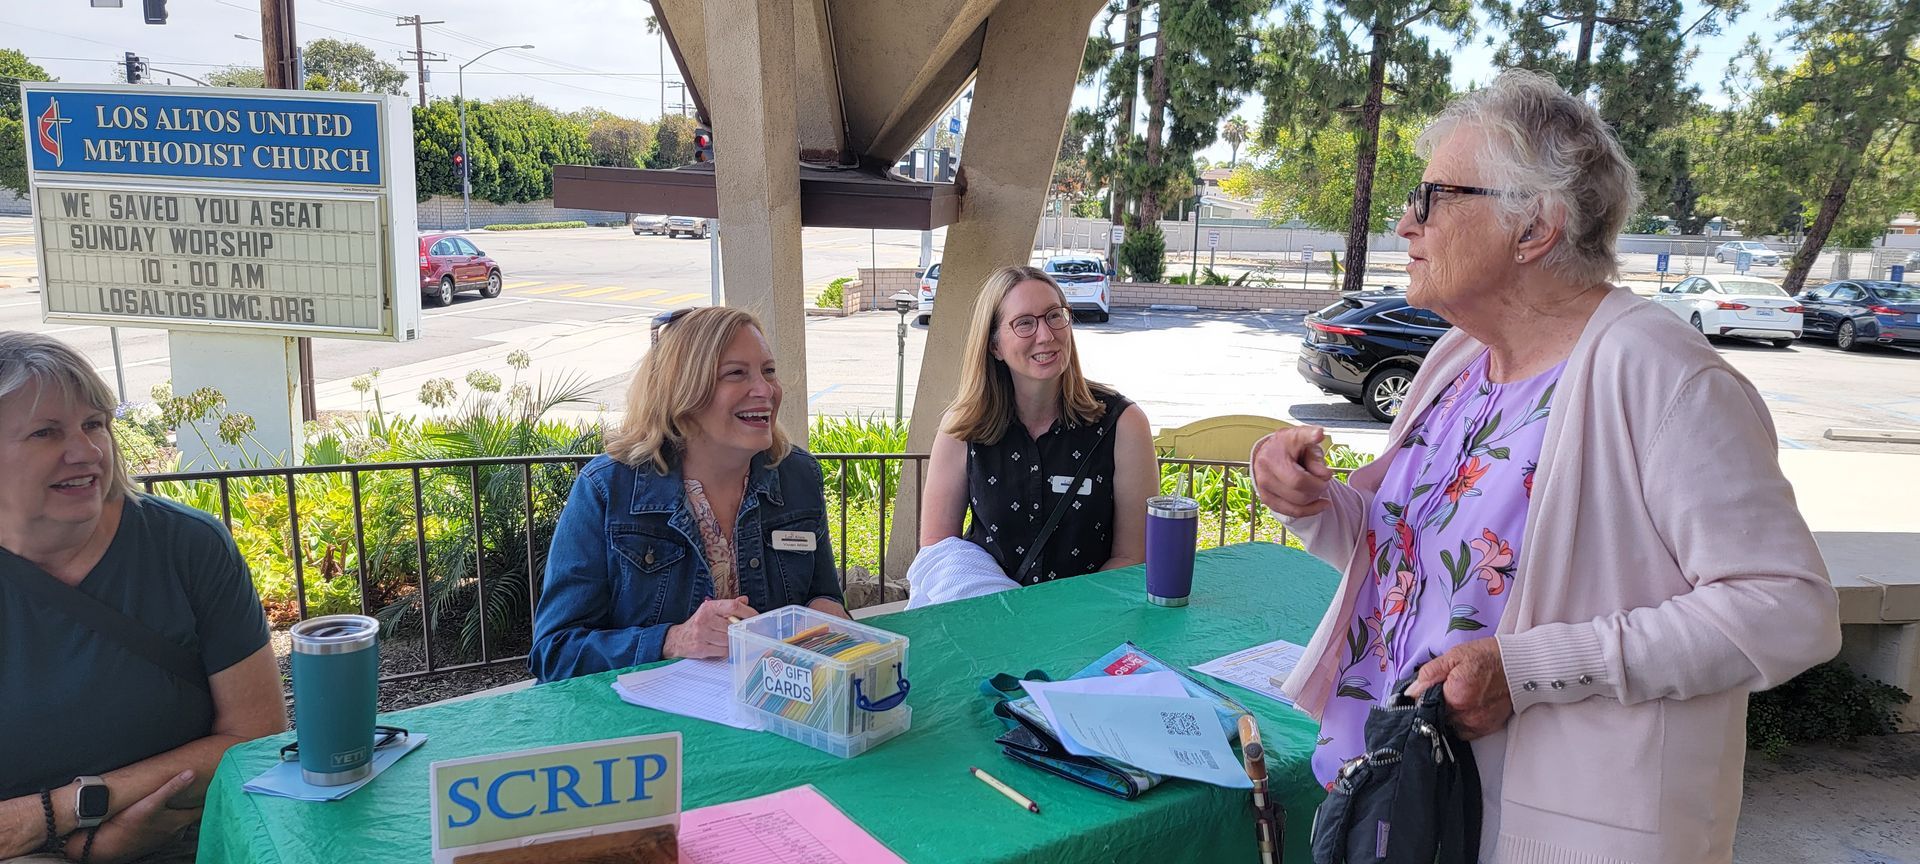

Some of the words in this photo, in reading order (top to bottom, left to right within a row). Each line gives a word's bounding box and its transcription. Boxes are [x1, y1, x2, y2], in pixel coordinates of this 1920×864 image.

[95, 105, 149, 130] LOS
[154, 107, 241, 134] ALTOS
[247, 111, 353, 137] UNITED
[83, 138, 246, 167] METHODIST
[252, 145, 370, 172] CHURCH
[61, 192, 91, 218] WE
[109, 194, 179, 221] SAVED
[194, 197, 240, 224] YOU
[250, 200, 264, 226] A
[270, 201, 323, 228] SEAT
[70, 224, 156, 252] SUNDAY
[169, 228, 274, 257] WORSHIP
[230, 263, 265, 289] AM
[763, 659, 768, 672] I
[785, 666, 811, 683] GIFT
[764, 675, 812, 702] CARDS
[334, 750, 365, 764] YETI
[448, 753, 668, 828] SCRIP
